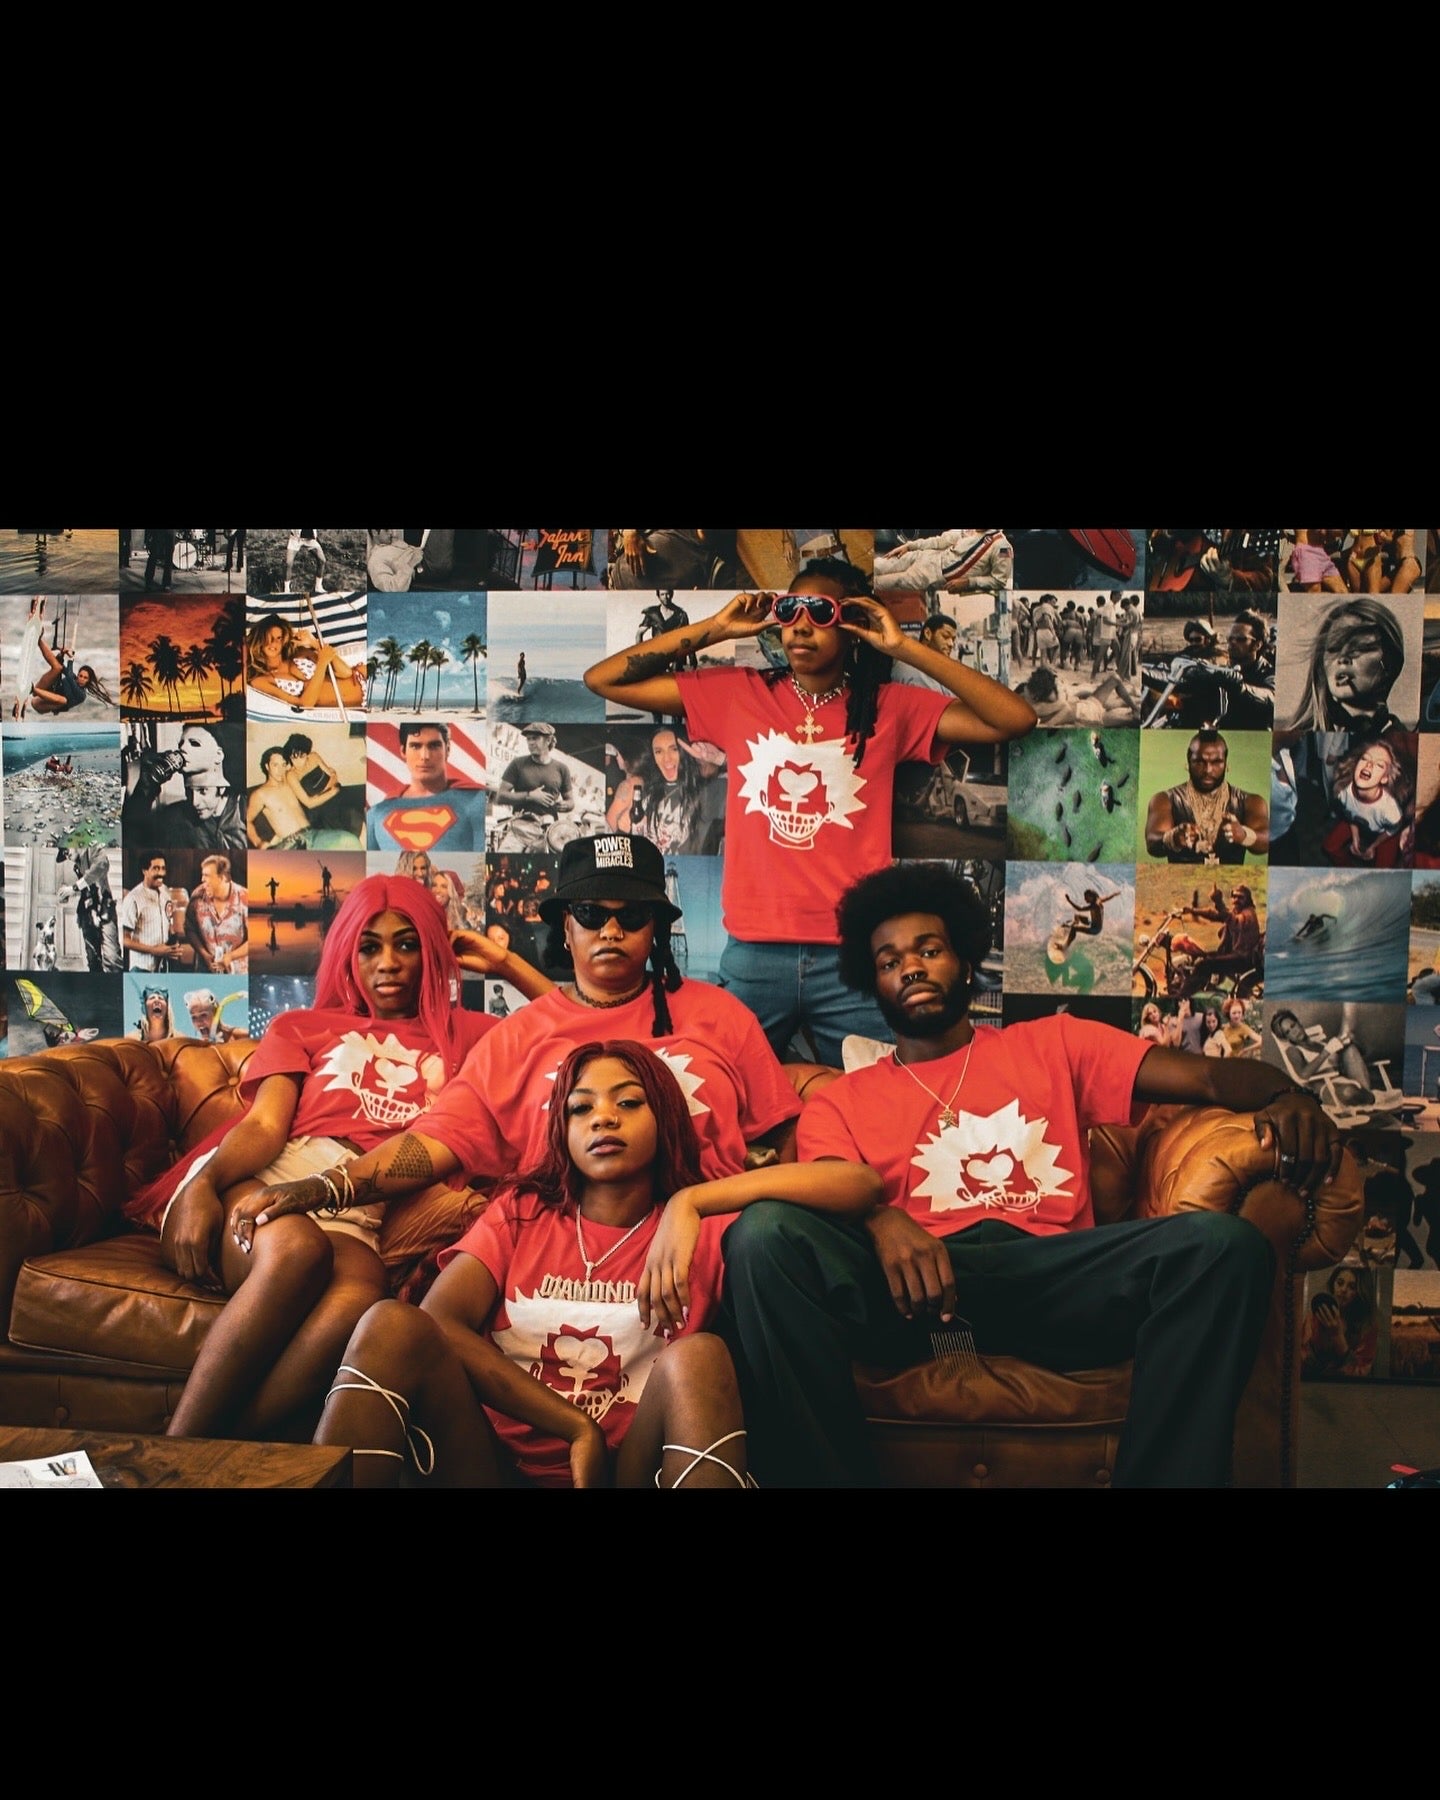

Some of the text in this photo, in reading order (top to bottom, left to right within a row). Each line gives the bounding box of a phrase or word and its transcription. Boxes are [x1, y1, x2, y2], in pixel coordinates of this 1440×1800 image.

[555, 544, 584, 568] Inn
[594, 836, 631, 852] POWER
[596, 854, 634, 868] MIRACLES
[540, 1273, 636, 1303] DIAMOND
